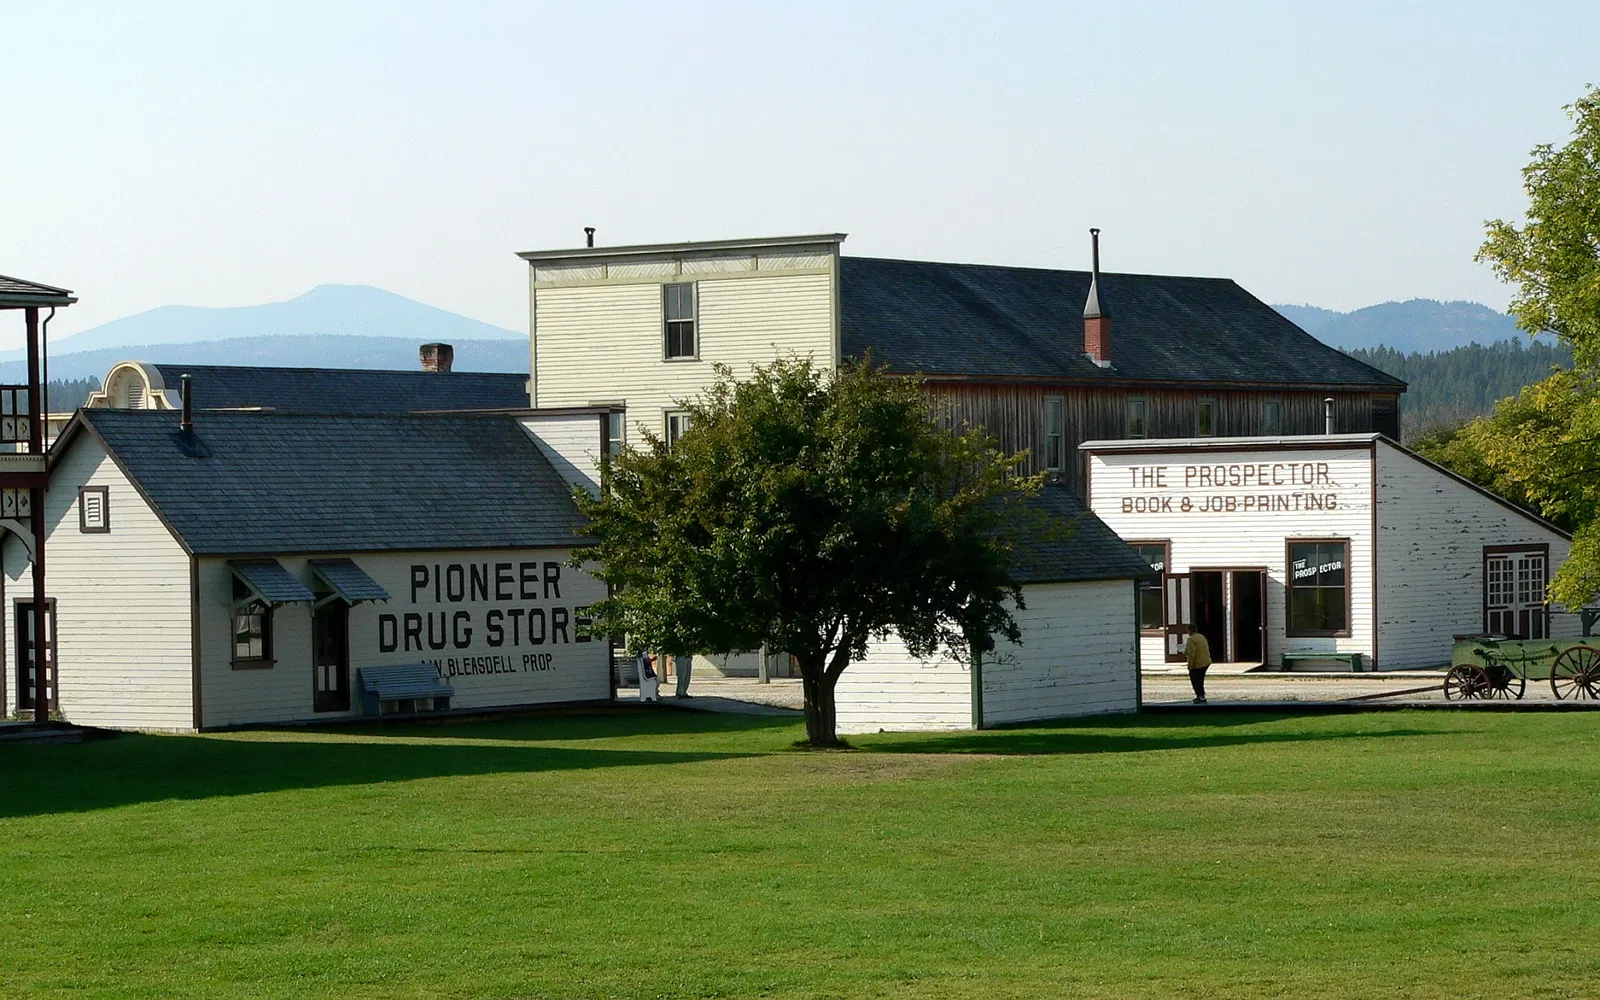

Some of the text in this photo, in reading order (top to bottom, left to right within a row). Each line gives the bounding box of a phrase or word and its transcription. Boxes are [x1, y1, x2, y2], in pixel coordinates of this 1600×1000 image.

[1128, 466, 1168, 488] THE
[1121, 497, 1173, 513] BOOK
[1180, 496, 1194, 513] &
[1294, 561, 1306, 570] THE
[410, 561, 561, 604] PIONEER
[379, 605, 593, 653] DRUG STORE
[522, 653, 556, 672] PROP.
